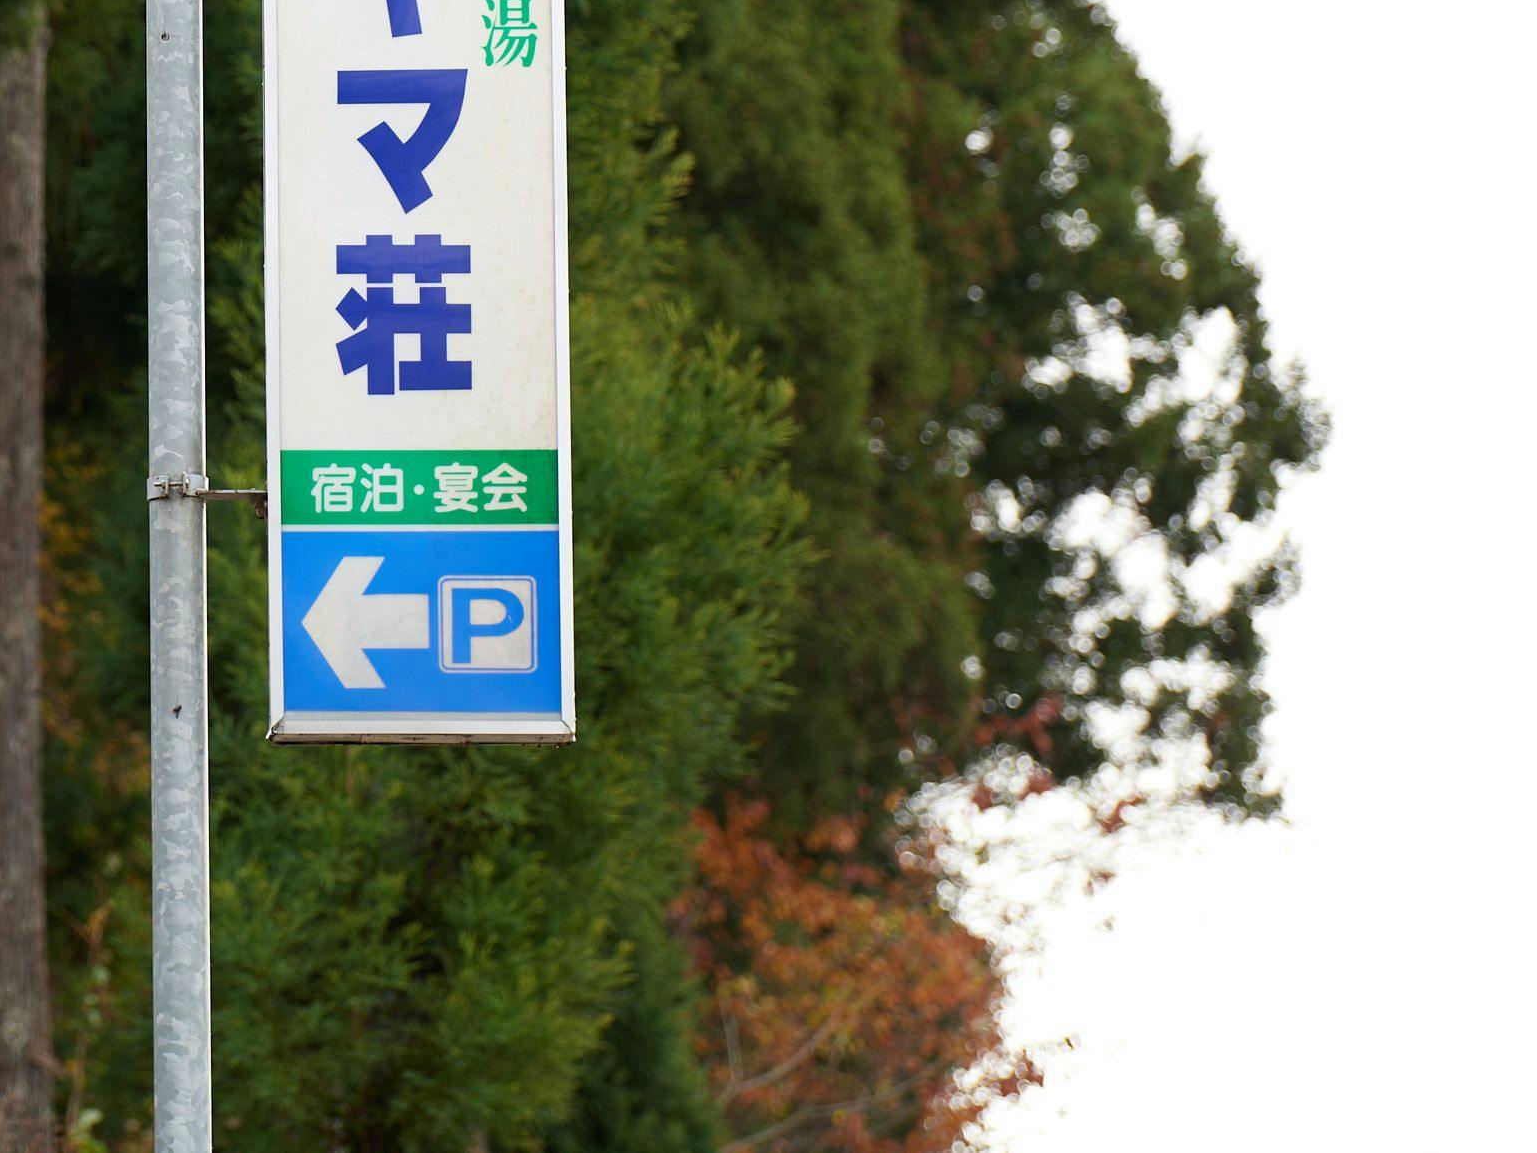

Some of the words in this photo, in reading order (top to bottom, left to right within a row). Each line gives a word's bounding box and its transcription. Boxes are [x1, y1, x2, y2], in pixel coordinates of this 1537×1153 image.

[311, 462, 528, 514] 宿泊・宴会
[451, 587, 525, 664] P
